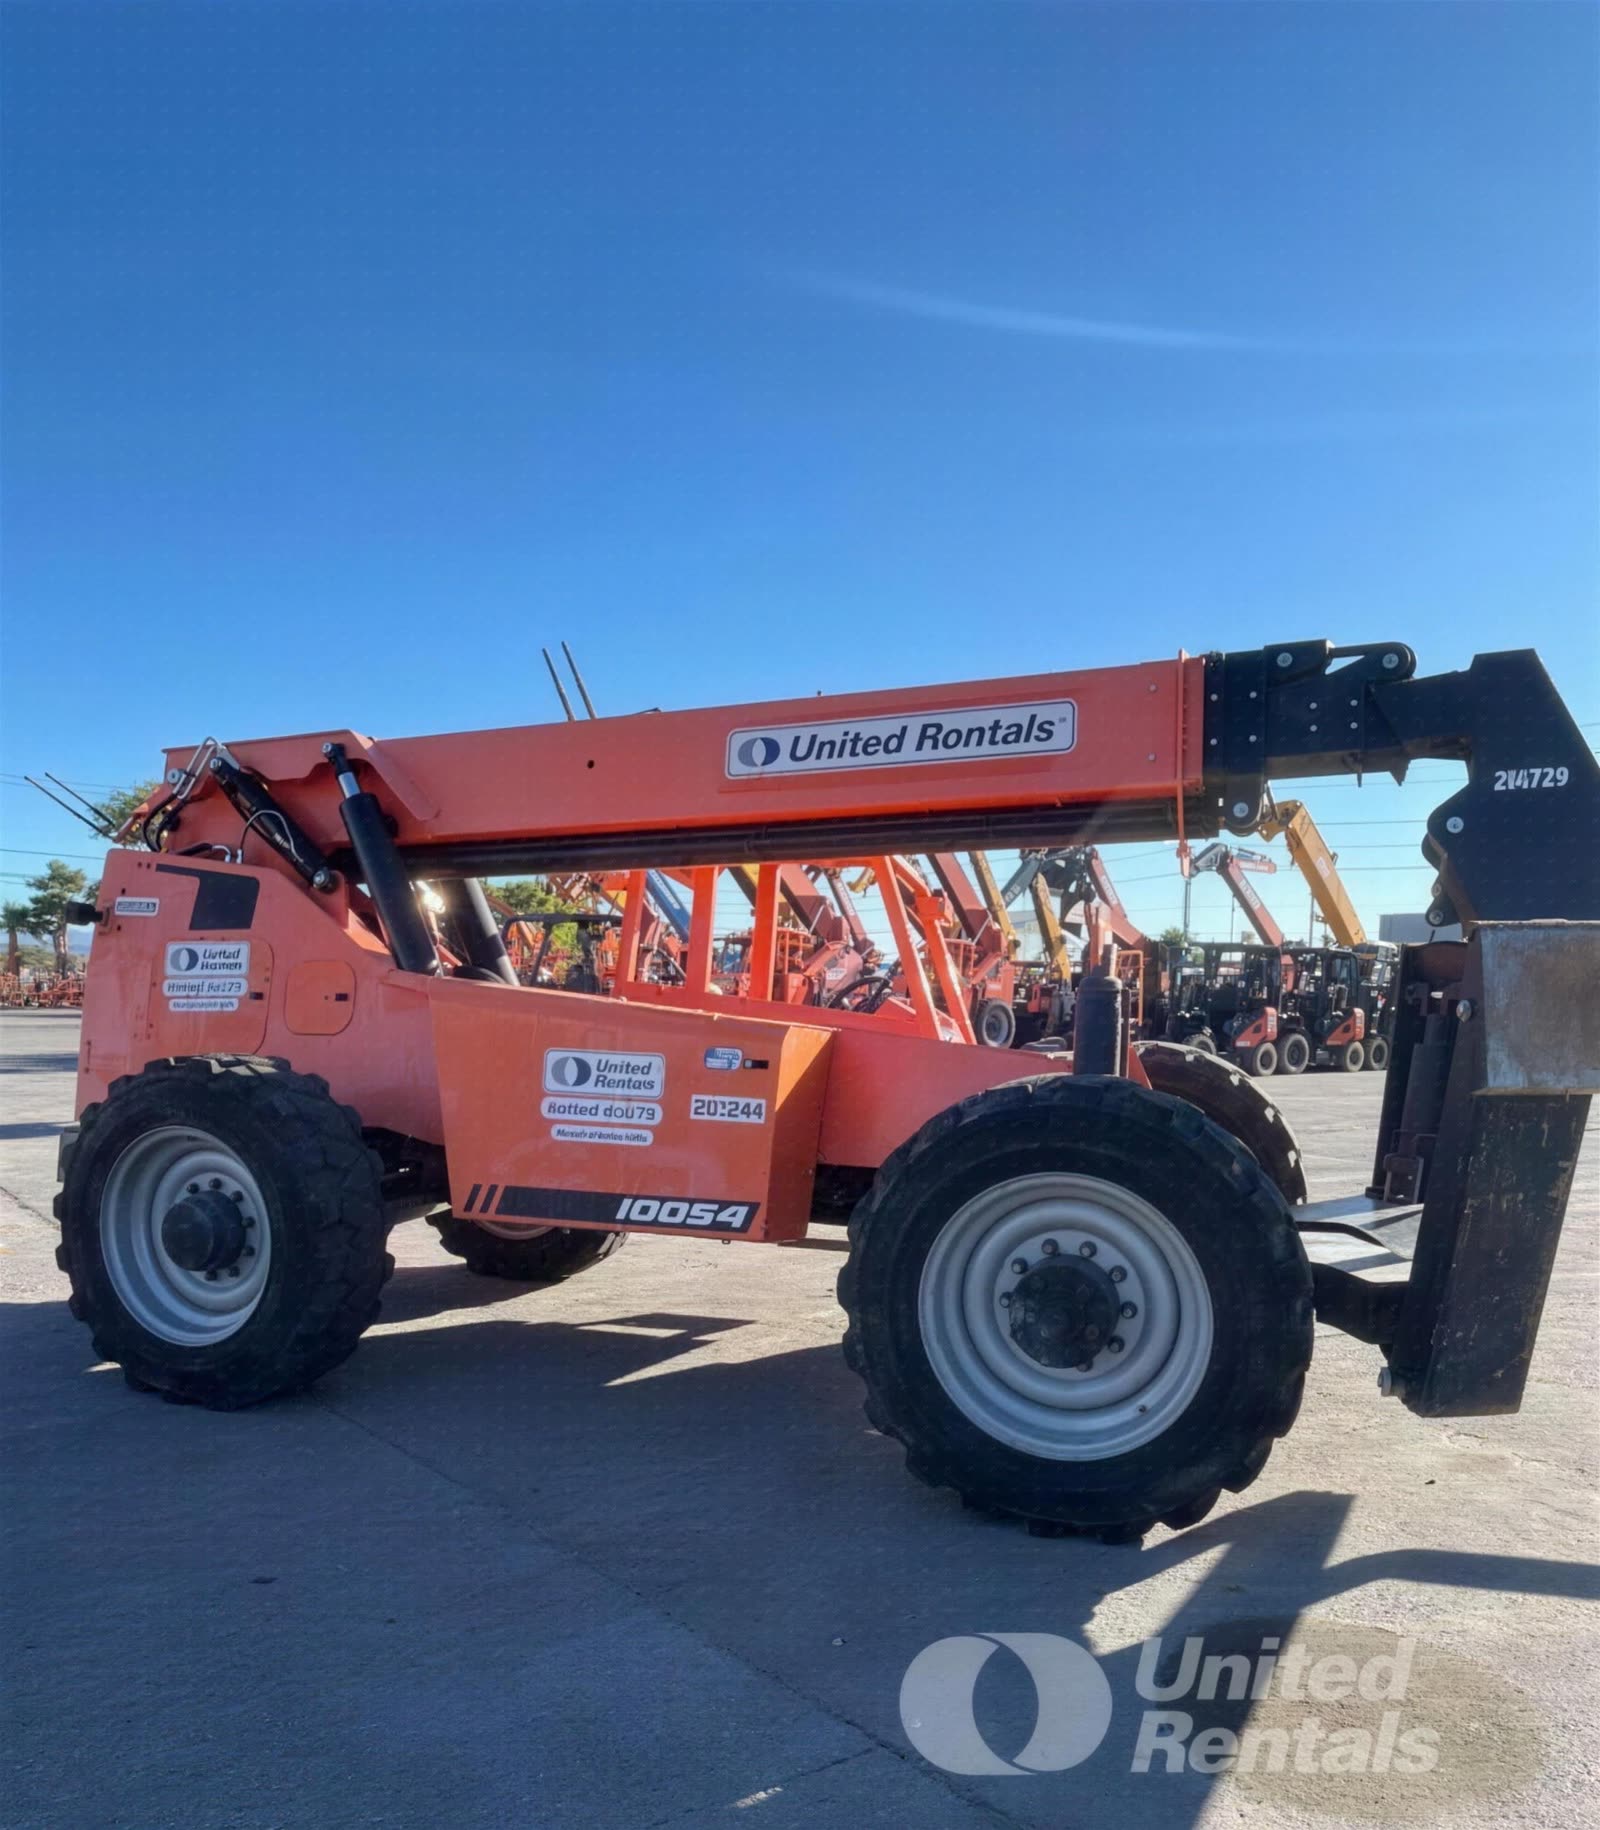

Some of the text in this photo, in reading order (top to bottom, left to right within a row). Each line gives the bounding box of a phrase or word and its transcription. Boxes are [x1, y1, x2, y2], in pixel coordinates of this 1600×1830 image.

[788, 725, 908, 763] United
[596, 1058, 653, 1076] United
[615, 1198, 749, 1229] 10054
